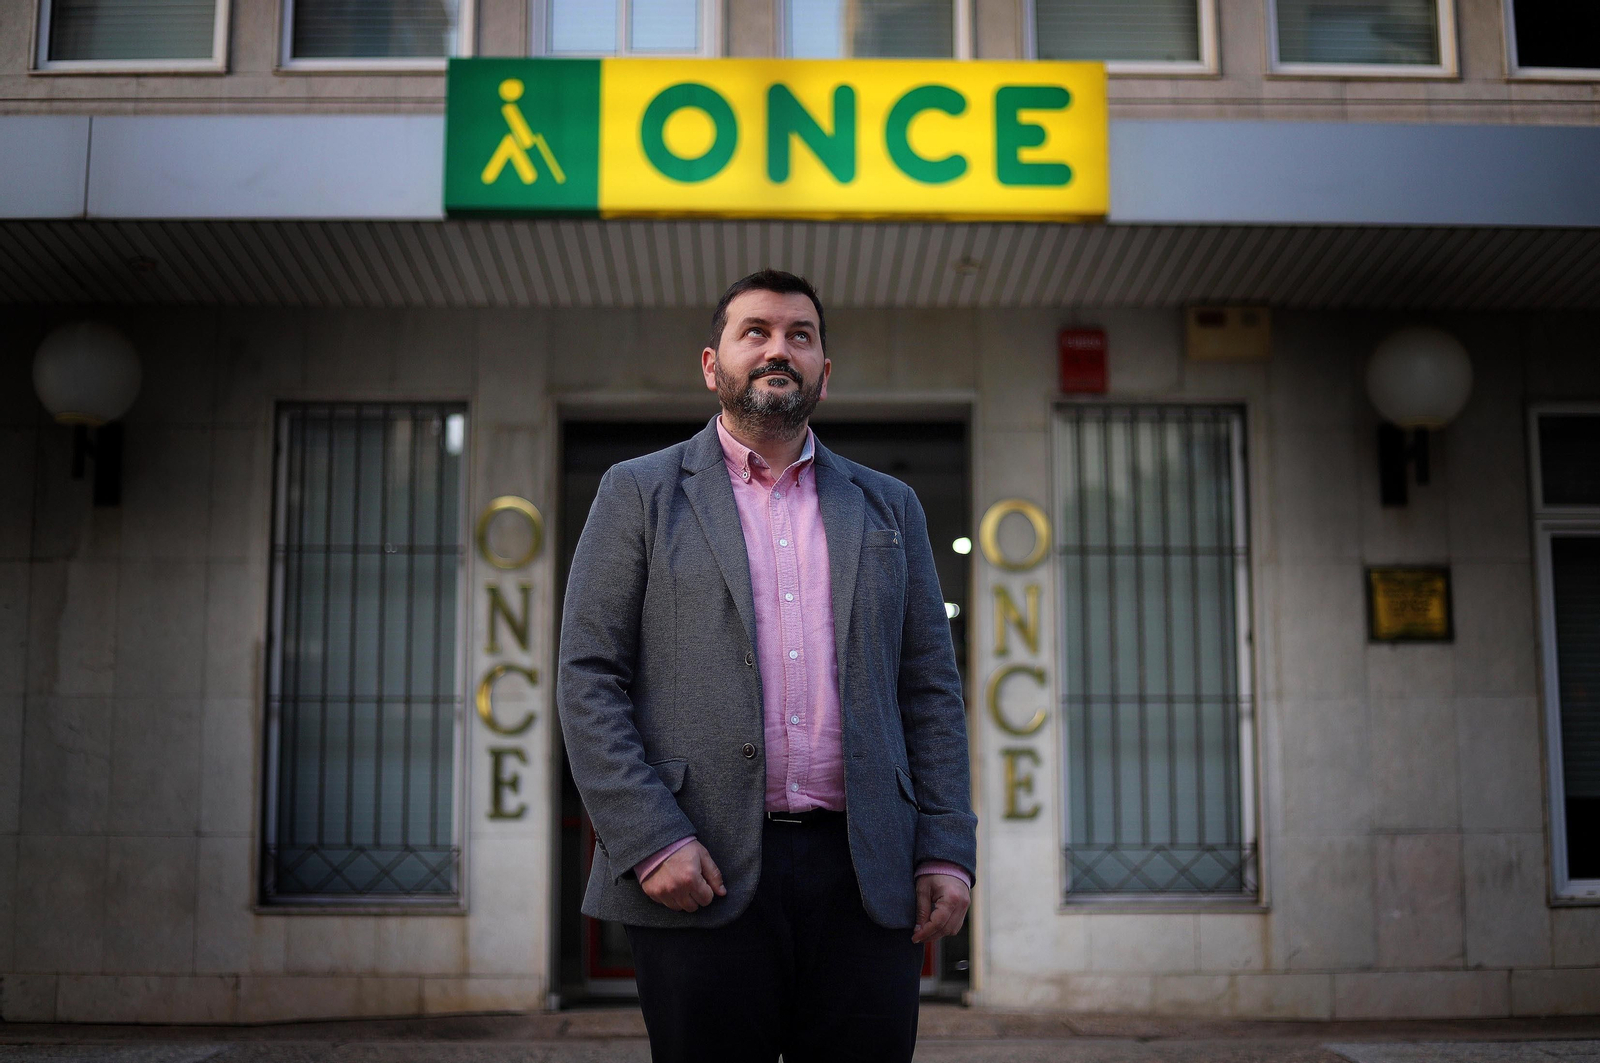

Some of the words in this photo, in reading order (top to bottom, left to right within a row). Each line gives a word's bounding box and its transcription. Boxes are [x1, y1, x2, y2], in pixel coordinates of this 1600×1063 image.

[641, 83, 1073, 187] ONCE
[476, 495, 543, 822] ONCE
[979, 499, 1051, 821] ONCE
